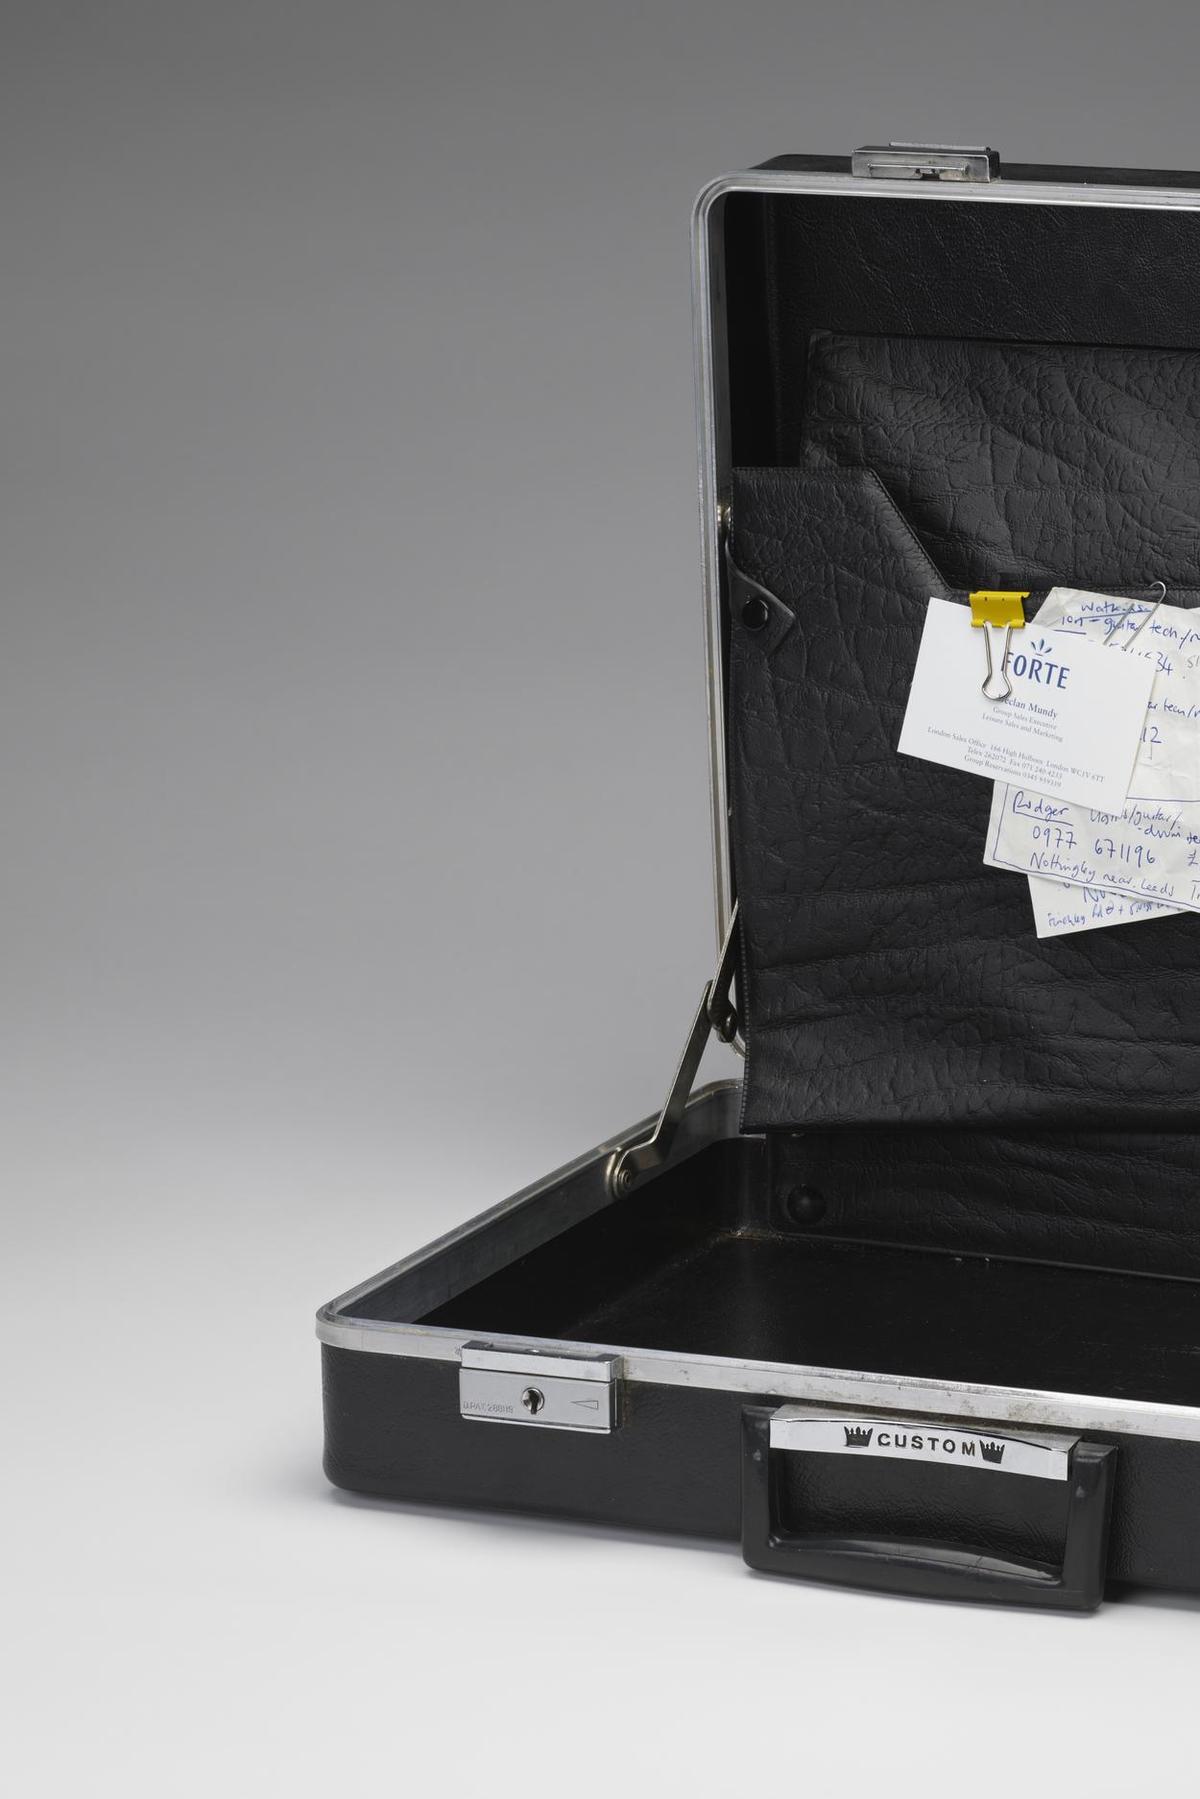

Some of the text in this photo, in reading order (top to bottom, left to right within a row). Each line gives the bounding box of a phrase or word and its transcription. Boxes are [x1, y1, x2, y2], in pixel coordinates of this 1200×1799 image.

[1013, 711, 1028, 722] Sales
[1029, 716, 1057, 730] Executive
[1028, 702, 1058, 720] Mundy
[1005, 719, 1020, 730] Sales
[1020, 723, 1032, 733] and
[1033, 727, 1064, 743] Marketing
[927, 726, 951, 739] London
[952, 732, 967, 744] Sales
[1003, 746, 1018, 759] High
[1046, 759, 1069, 773] London
[985, 759, 1024, 778] Reservations
[1033, 825, 1077, 849] 0977
[1094, 838, 1156, 868] 671196
[877, 1432, 976, 1457] CUSTOM
